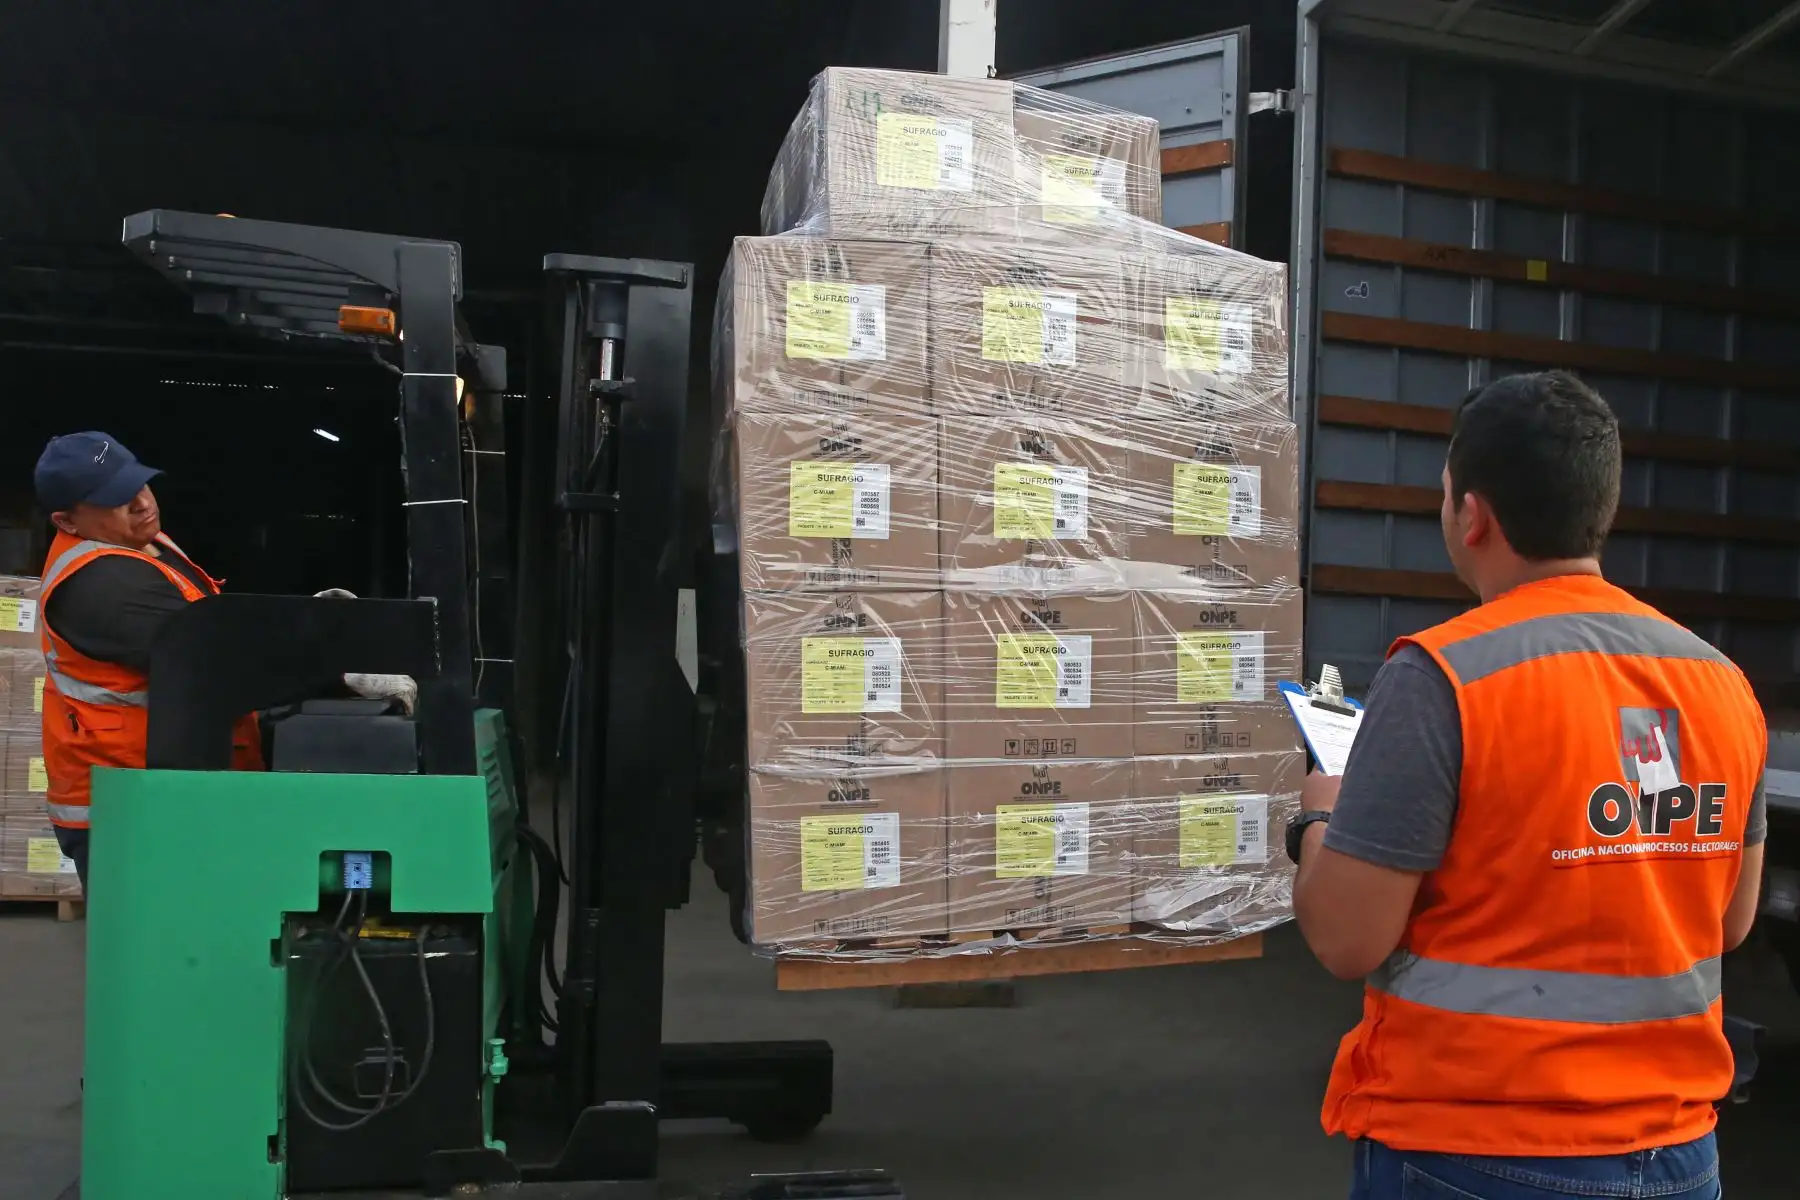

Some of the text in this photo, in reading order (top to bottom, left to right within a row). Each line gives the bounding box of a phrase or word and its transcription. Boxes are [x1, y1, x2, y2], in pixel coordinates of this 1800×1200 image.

[902, 126, 948, 137] SUFRAGIO
[813, 294, 860, 304] SUFRAGIO
[1008, 300, 1052, 311] SUFRAGIO
[817, 473, 864, 483] SUFRAGIO
[1019, 477, 1064, 486] SUFRAGIO
[1197, 475, 1239, 484] SUFRAGIO
[1020, 611, 1062, 624] ONPE
[1199, 610, 1238, 624] ONPE
[1023, 646, 1067, 655] SUFRAGIO
[1200, 642, 1241, 650] SUFRAGIO
[828, 649, 875, 658] SUFRAGIO
[1203, 773, 1241, 787] ONPE
[1021, 781, 1062, 795] ONPE
[828, 788, 870, 802] ONPE
[1203, 806, 1245, 815] SUFRAGIO
[1021, 815, 1065, 824] SUFRAGIO
[827, 826, 874, 835] SUFRAGIO
[1552, 847, 1596, 860] OFICINA
[1691, 840, 1740, 853] ELECTORALES
